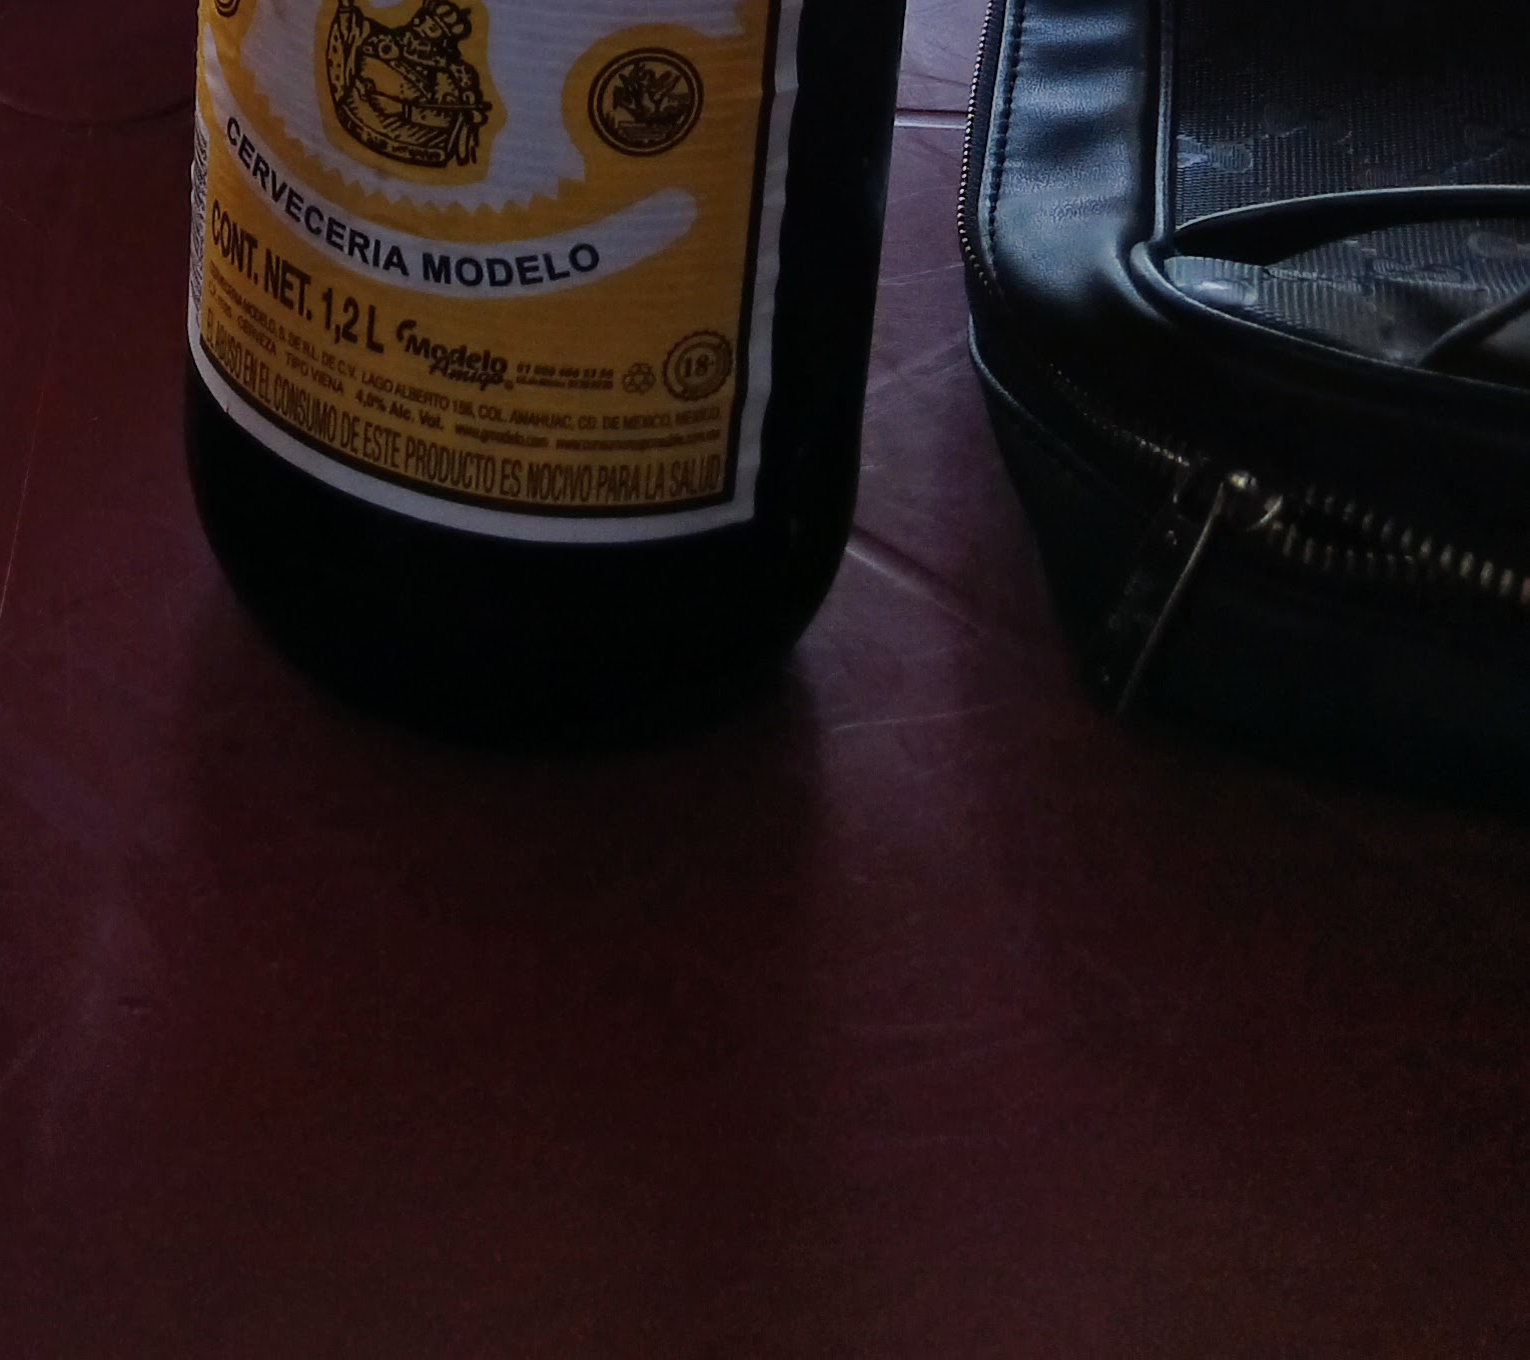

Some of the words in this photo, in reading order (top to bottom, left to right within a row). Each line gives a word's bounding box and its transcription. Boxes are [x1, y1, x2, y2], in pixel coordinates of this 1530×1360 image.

[227, 117, 409, 277] CERVECERIA
[422, 243, 601, 288] MODELO
[211, 199, 259, 285] CONT.
[264, 247, 312, 321] NET.
[322, 287, 359, 344] 1,2
[367, 305, 384, 354] L
[286, 351, 309, 377] TIPO
[310, 368, 345, 395] VIENA
[321, 351, 336, 370] DE
[402, 330, 509, 375] Modelo
[274, 373, 338, 443] CONSUMO
[339, 409, 360, 455] DE
[362, 420, 400, 469] ESTE
[404, 435, 496, 495] PRODUCTO
[499, 457, 523, 498] ES
[526, 462, 593, 503] NOCIVO
[596, 464, 642, 503] PARA
[644, 461, 665, 501] LA
[668, 454, 722, 498] SALUD
